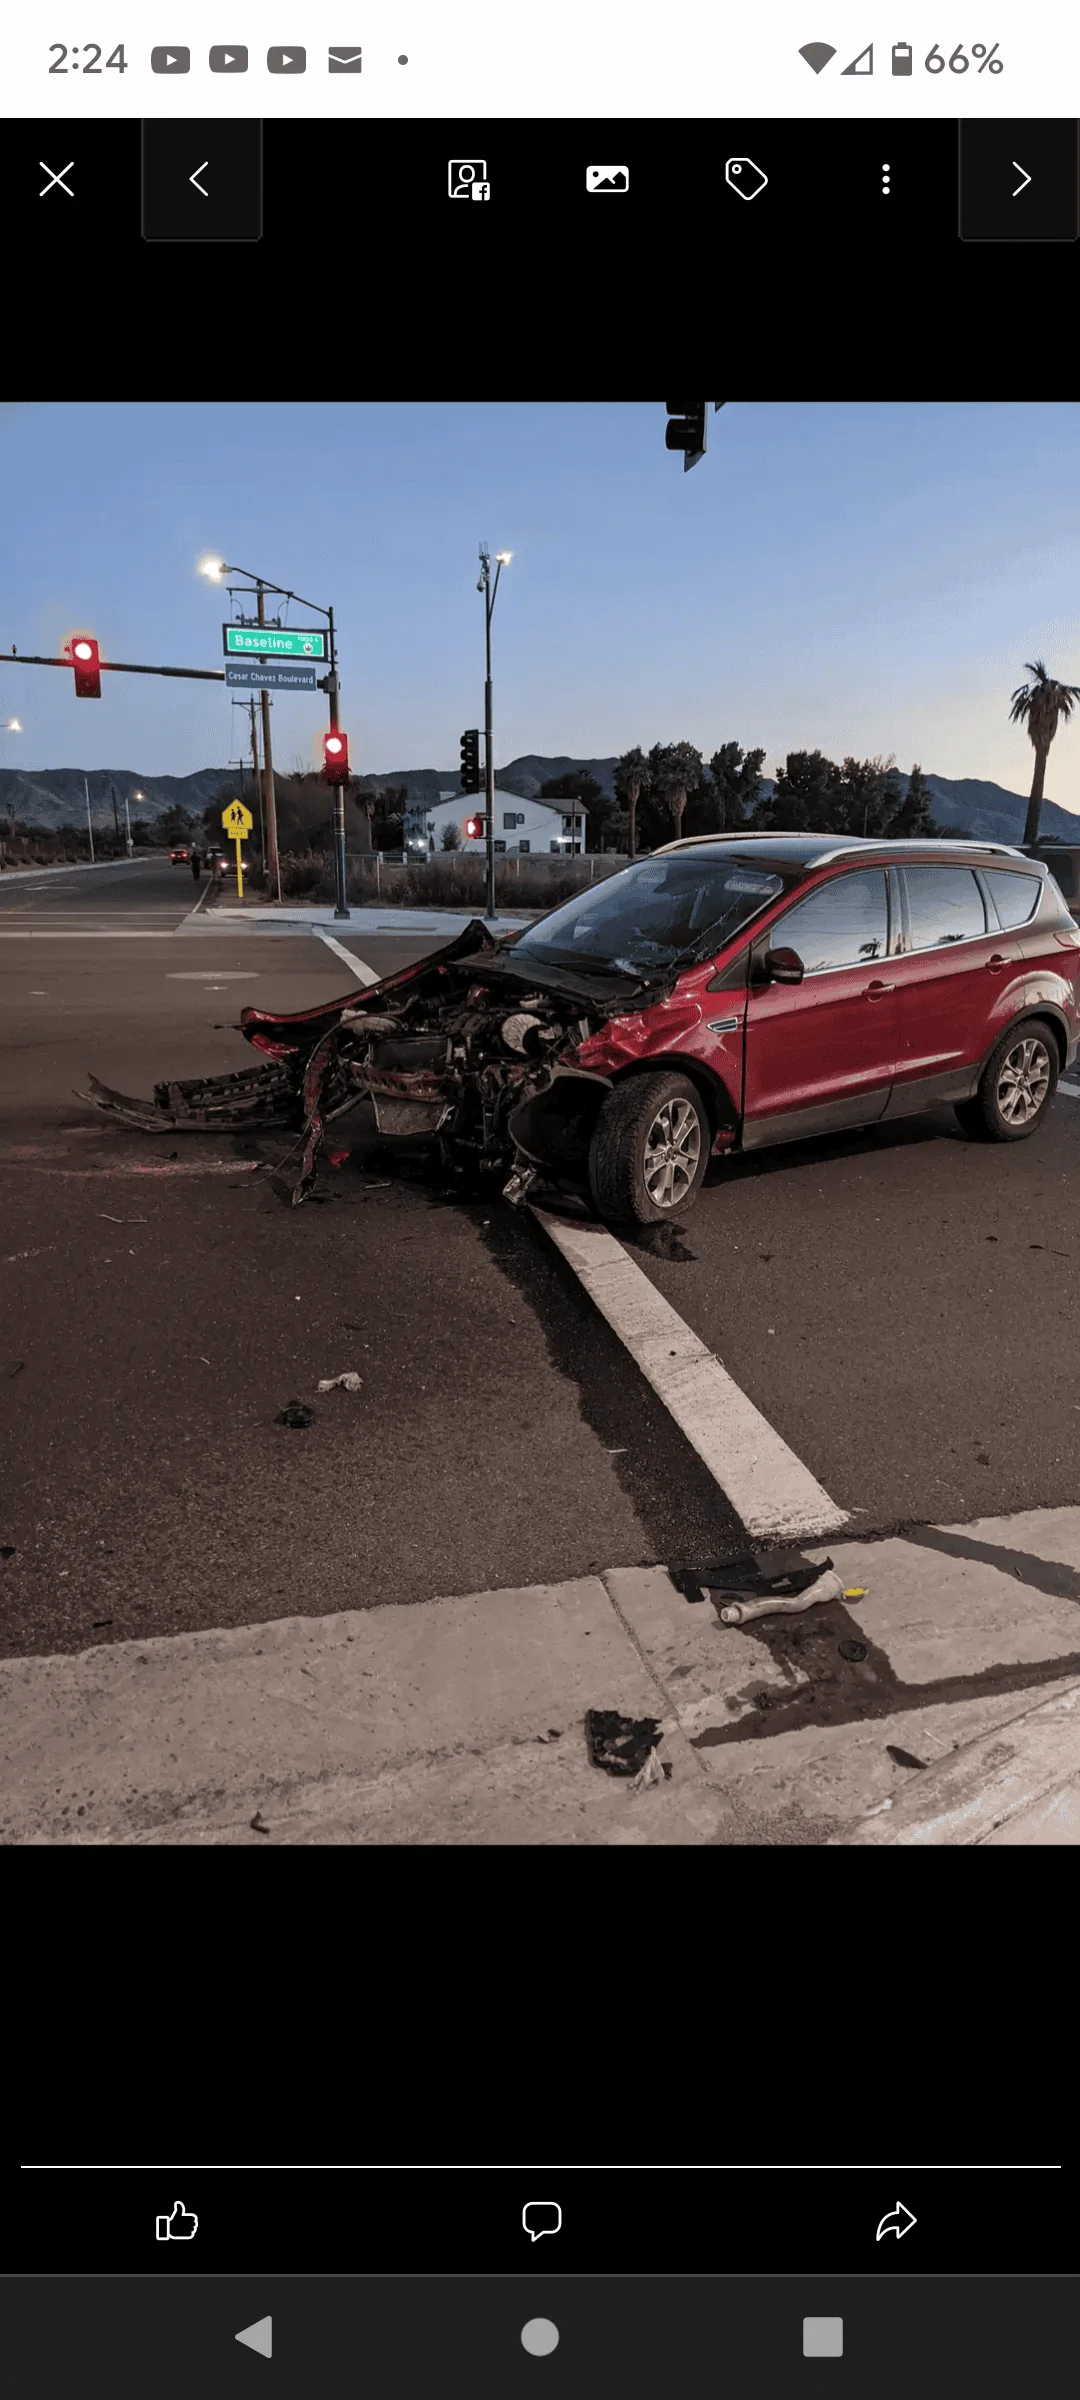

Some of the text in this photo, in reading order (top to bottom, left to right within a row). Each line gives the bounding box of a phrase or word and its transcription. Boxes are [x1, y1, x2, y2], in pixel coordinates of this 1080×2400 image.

[234, 634, 294, 650] Baseline
[228, 671, 314, 684] Cesar Chavez Boulevard
